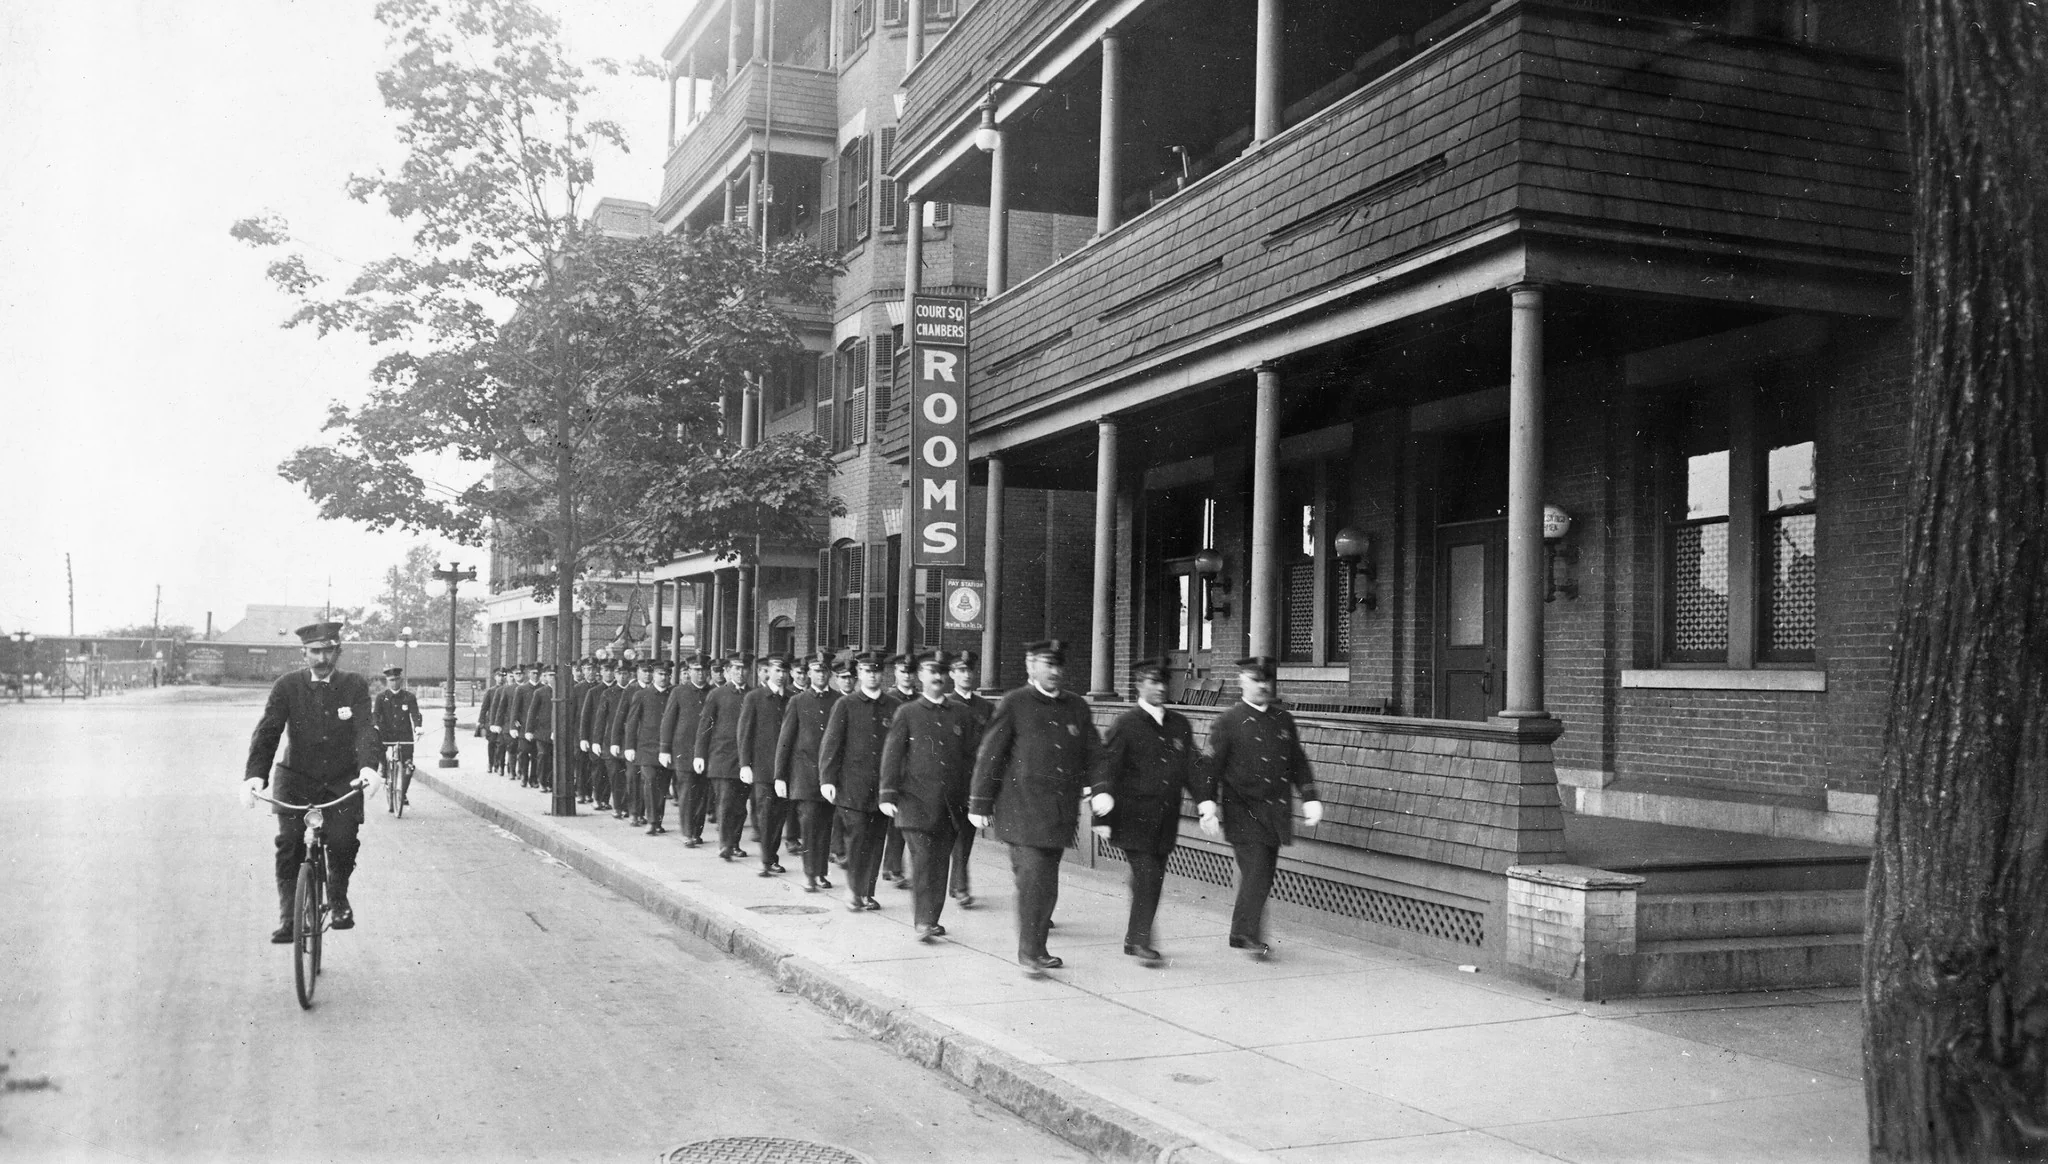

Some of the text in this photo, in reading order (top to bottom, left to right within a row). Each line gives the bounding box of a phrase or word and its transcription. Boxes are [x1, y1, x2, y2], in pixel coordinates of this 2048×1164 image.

[916, 304, 947, 318] COURT
[916, 323, 964, 337] CHAMBERS
[923, 349, 958, 554] ROOMS
